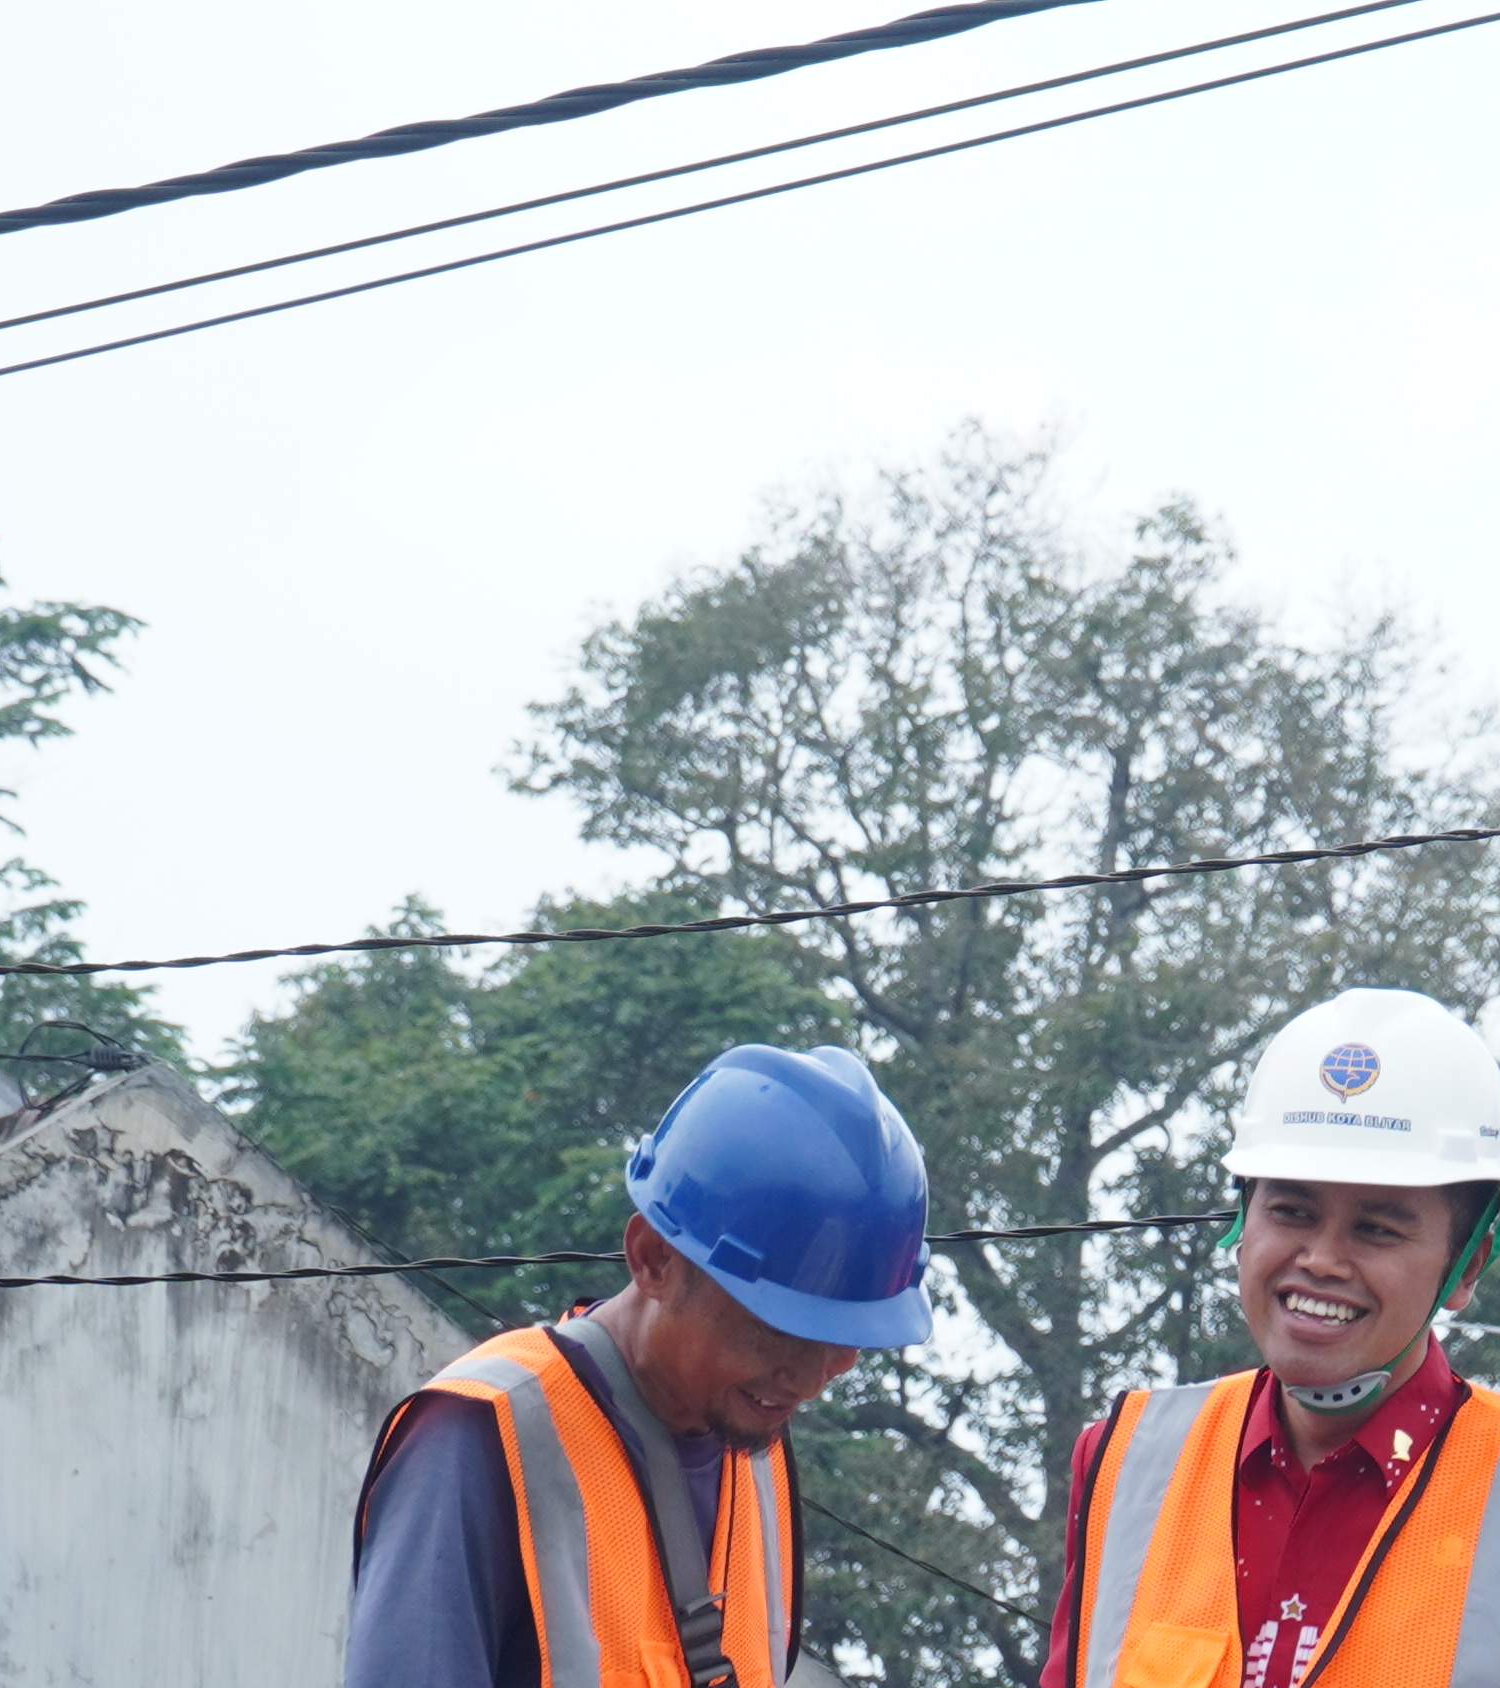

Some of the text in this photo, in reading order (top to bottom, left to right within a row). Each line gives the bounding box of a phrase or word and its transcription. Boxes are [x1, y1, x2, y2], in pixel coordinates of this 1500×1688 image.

[1283, 1111, 1412, 1132] DISHUB KOTA BLITAR
